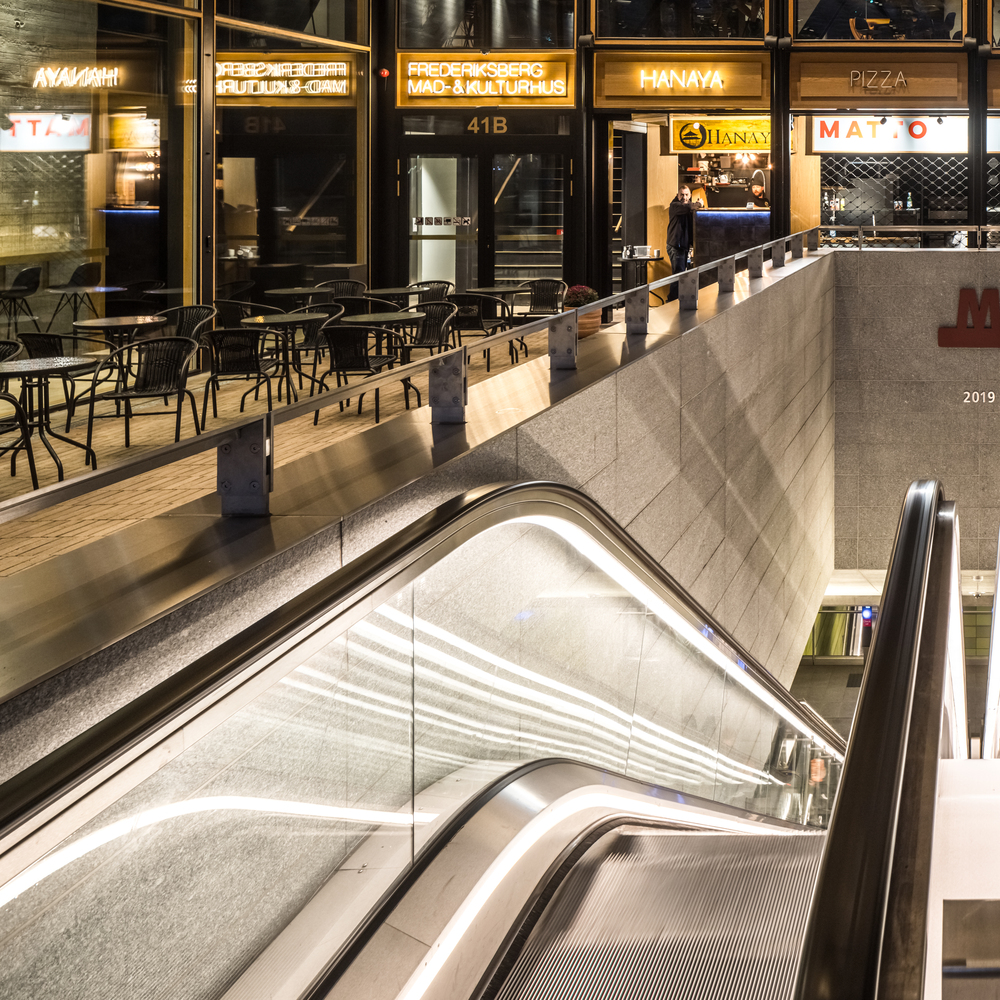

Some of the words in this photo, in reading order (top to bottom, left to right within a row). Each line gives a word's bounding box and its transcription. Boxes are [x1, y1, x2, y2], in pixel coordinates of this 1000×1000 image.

[407, 62, 544, 78] FREDERIKSBERG
[640, 69, 724, 89] HANAYA
[849, 70, 908, 88] PIZZA
[467, 116, 508, 134] 41B
[707, 129, 771, 144] HANAY
[963, 391, 996, 403] 2019
